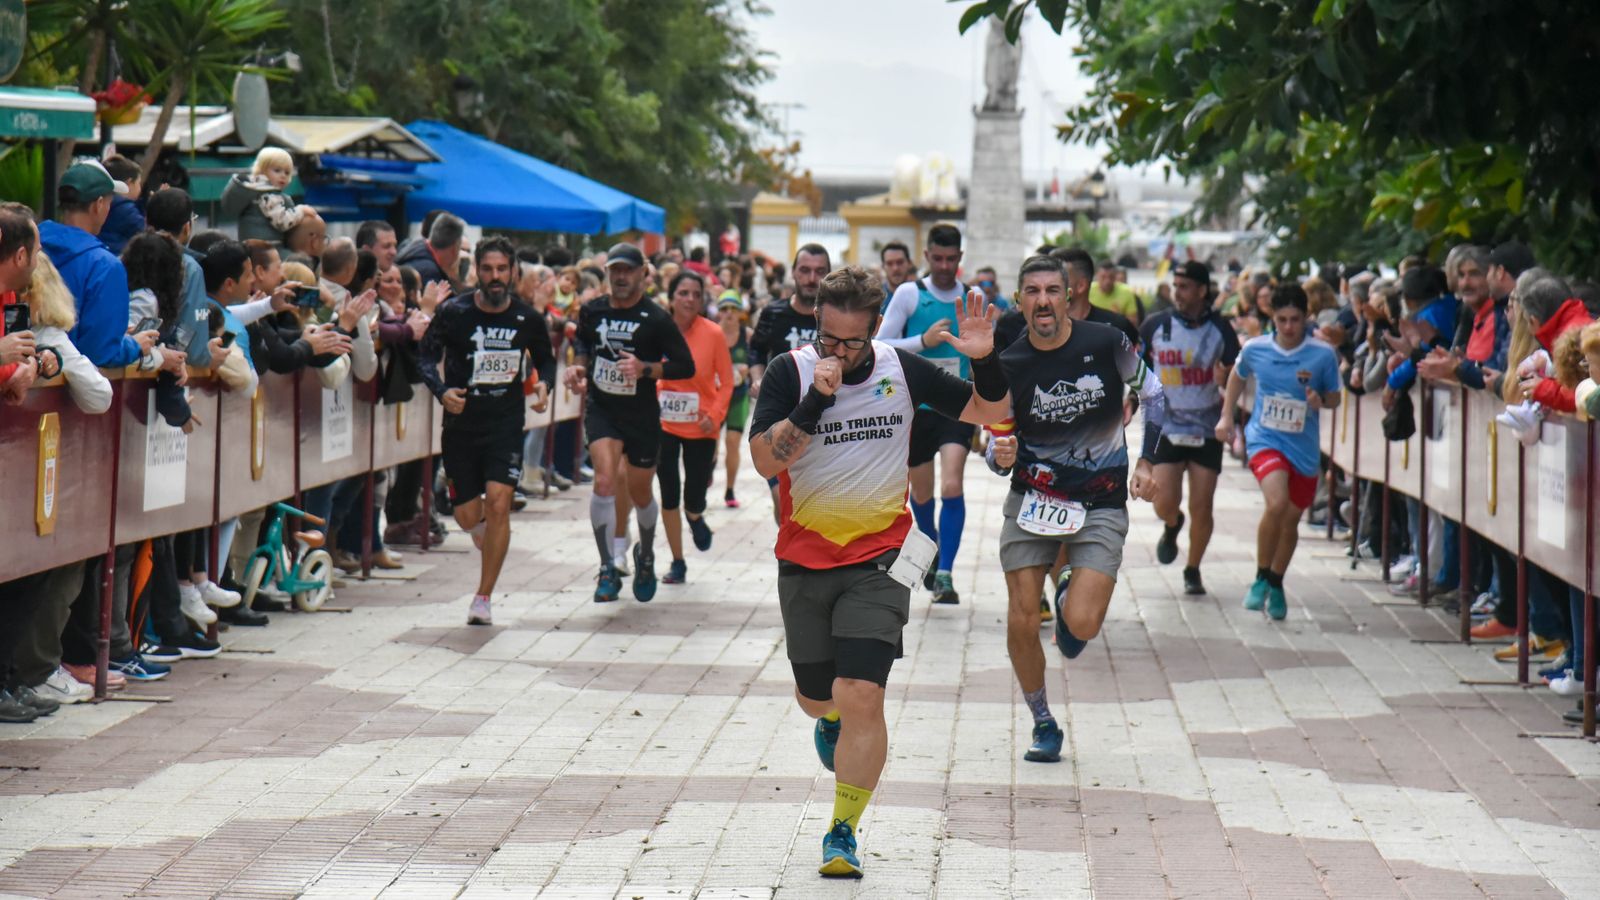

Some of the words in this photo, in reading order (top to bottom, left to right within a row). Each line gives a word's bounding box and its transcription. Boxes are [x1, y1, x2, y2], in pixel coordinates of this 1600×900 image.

[608, 320, 640, 333] XIV
[486, 327, 518, 341] XIV
[800, 329, 818, 340] XI
[485, 359, 509, 372] 383
[604, 368, 624, 383] 184
[667, 400, 688, 412] 487
[1036, 399, 1099, 423] TRAIL
[1273, 406, 1293, 421] 111
[846, 413, 903, 430] TRIATLÓN
[823, 427, 894, 446] ALGECIRAS
[1035, 492, 1055, 504] XIV
[1038, 503, 1069, 526] 170
